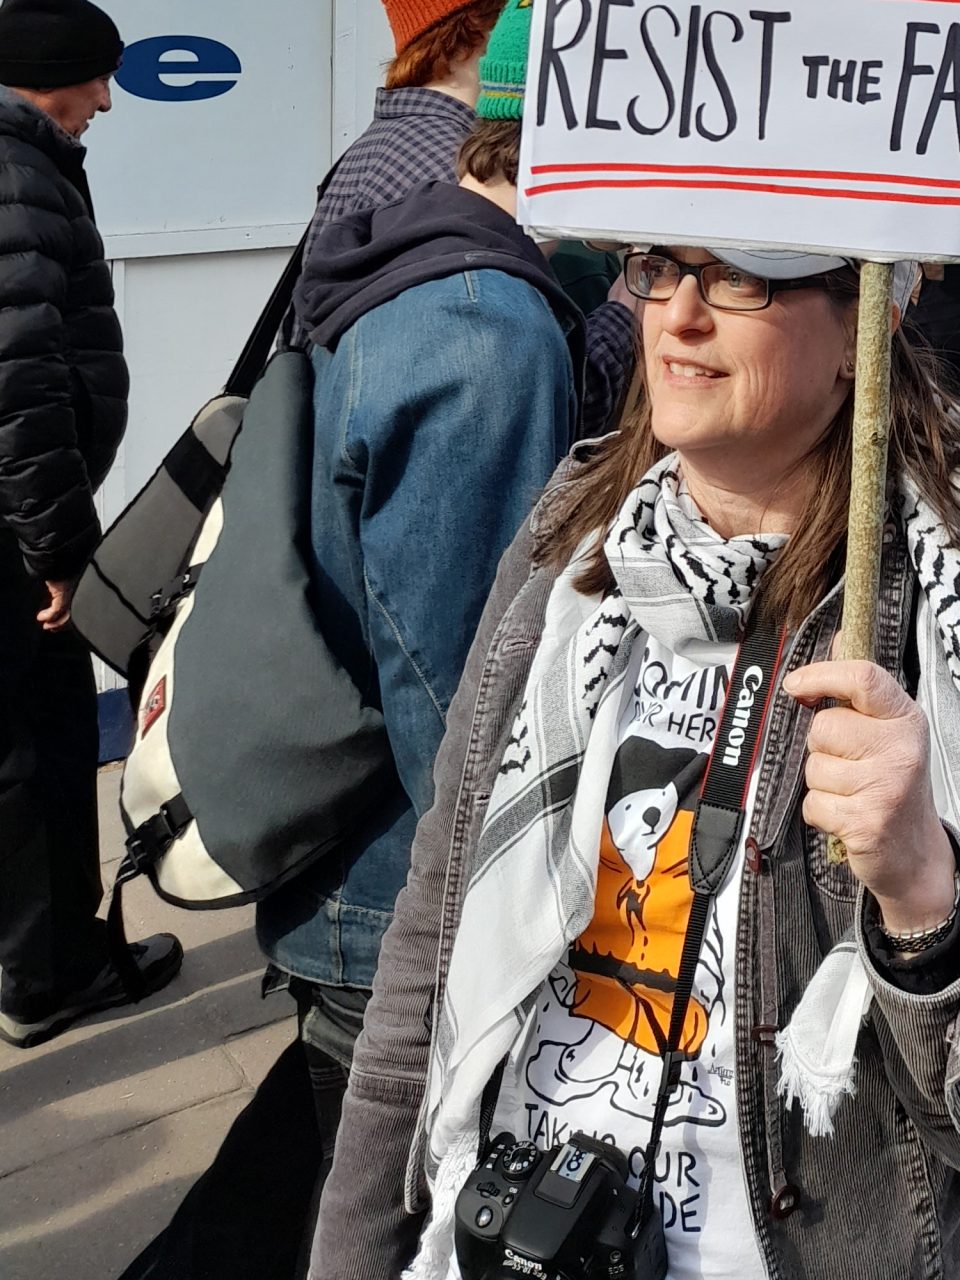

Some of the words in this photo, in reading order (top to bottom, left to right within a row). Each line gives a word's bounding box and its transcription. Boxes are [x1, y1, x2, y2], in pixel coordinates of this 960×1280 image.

[801, 55, 884, 106] THE
[667, 711, 719, 743] HER
[722, 665, 763, 767] Canon
[628, 1146, 700, 1188] OUR
[504, 1249, 543, 1271] Canon
